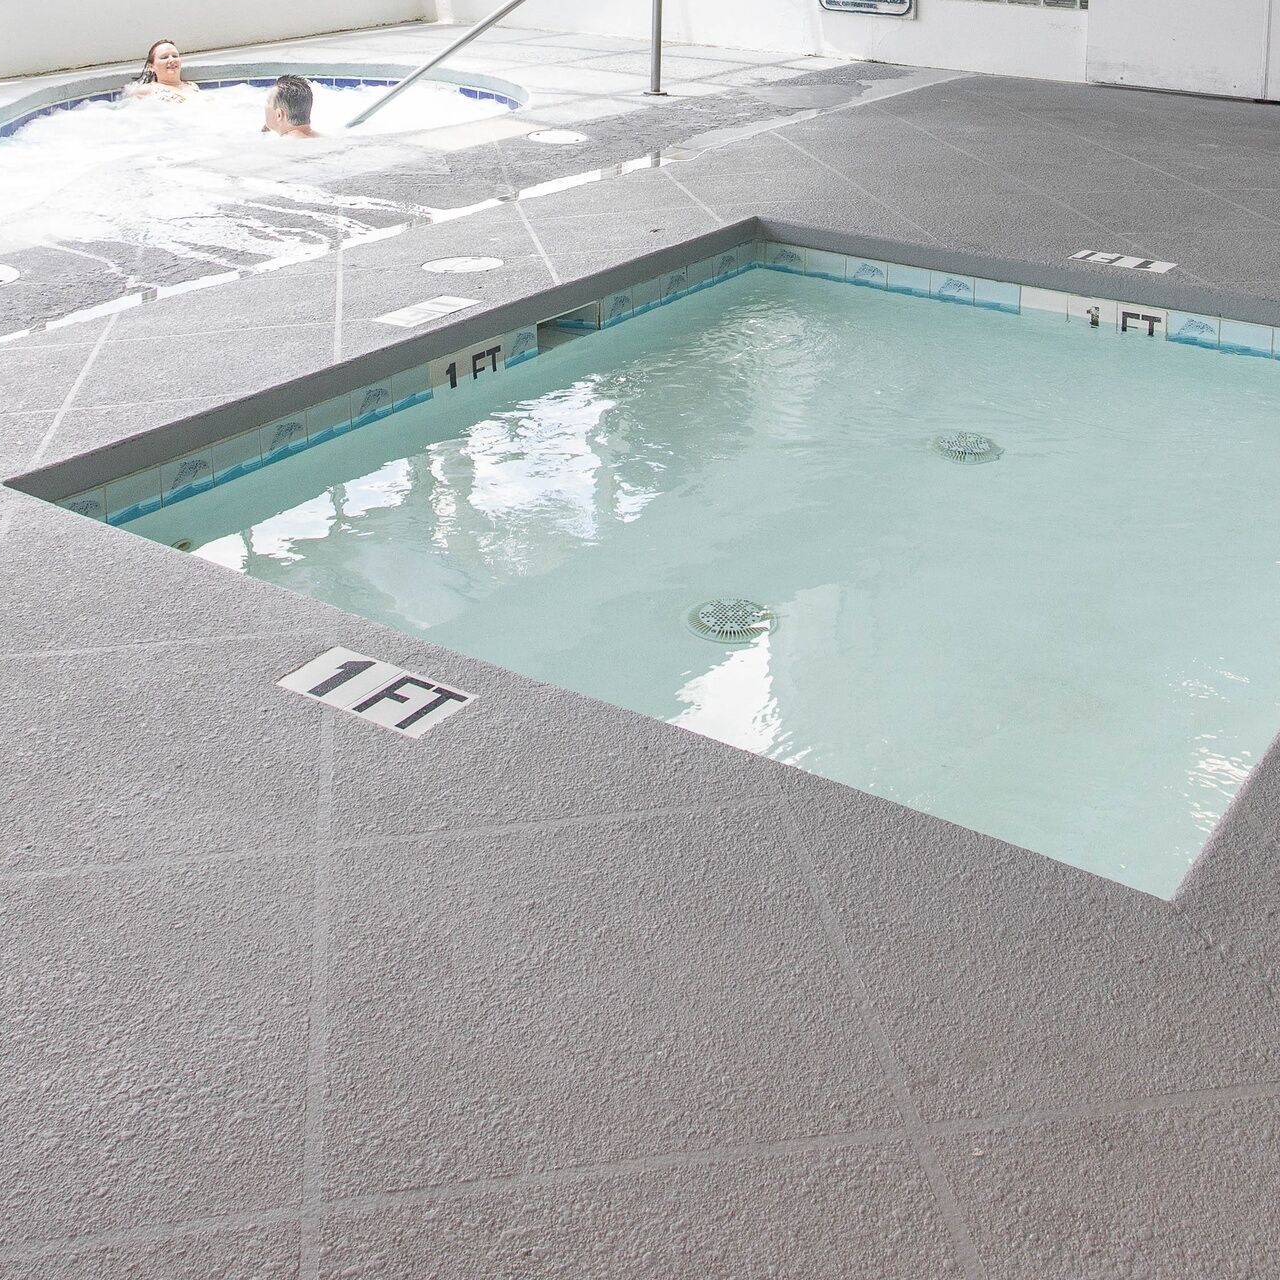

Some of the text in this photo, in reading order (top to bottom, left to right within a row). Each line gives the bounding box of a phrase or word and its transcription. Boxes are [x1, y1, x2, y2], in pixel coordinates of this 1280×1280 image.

[1086, 306, 1100, 329] 1
[445, 345, 501, 389] 1 FT
[306, 661, 469, 730] 1 FT
